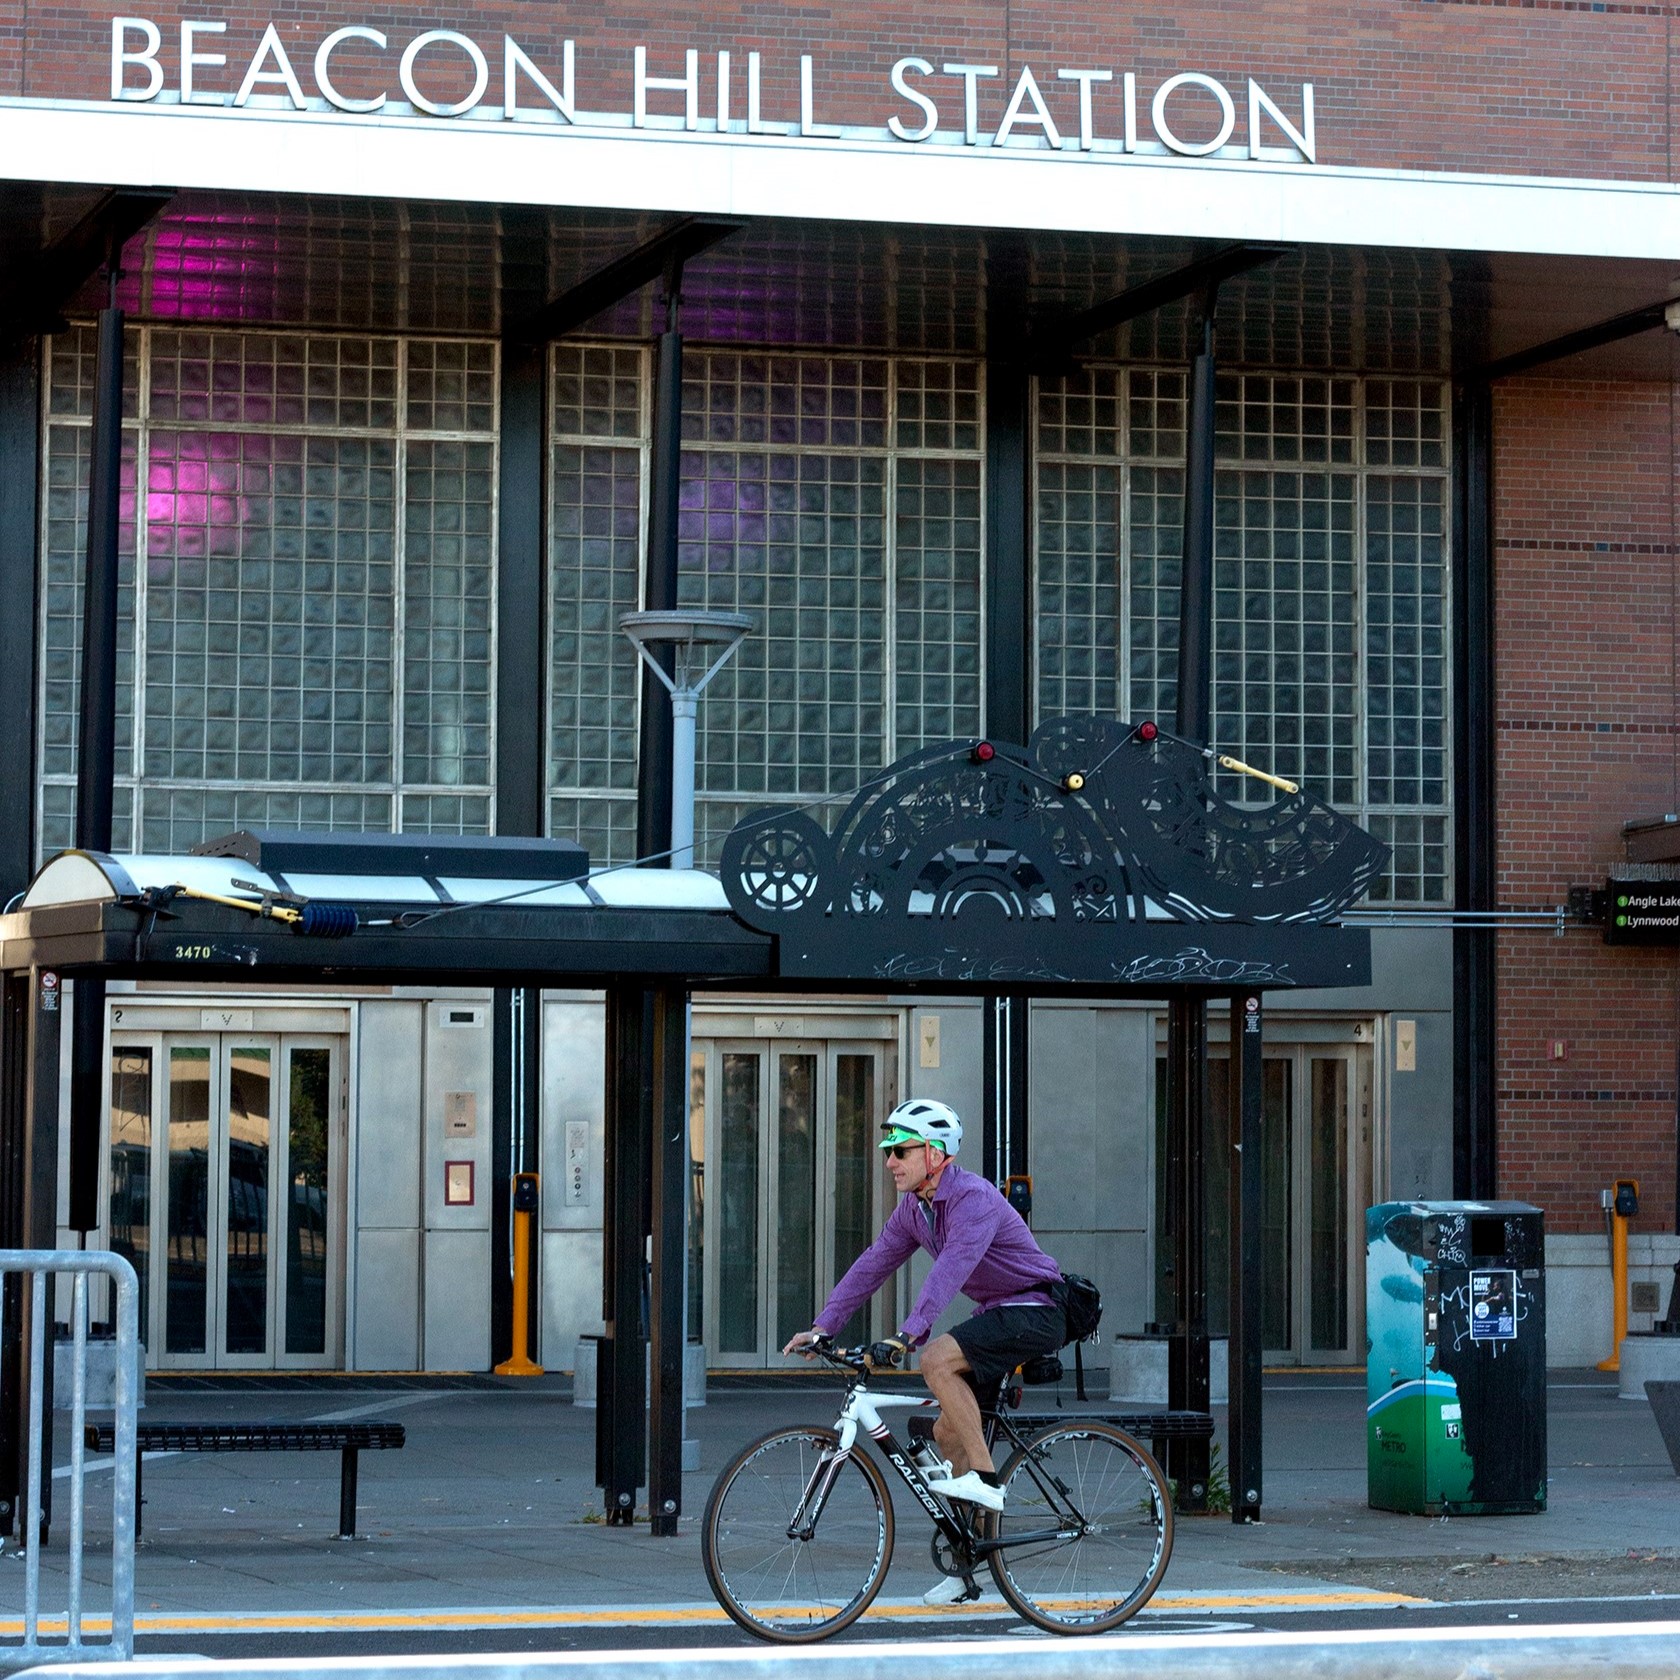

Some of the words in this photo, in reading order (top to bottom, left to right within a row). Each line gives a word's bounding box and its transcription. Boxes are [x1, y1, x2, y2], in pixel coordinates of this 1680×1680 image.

[111, 16, 575, 125] BEACON
[633, 46, 842, 139] HILL
[887, 56, 1316, 164] STATION
[1628, 895, 1657, 909] Angle
[1660, 895, 1680, 907] Lake
[1627, 915, 1680, 929] Lynnwood
[175, 945, 211, 959] 3470
[114, 1010, 123, 1023] 2
[1353, 1024, 1362, 1037] 4
[1381, 1440, 1407, 1454] METRO
[889, 1453, 945, 1520] RALEIGH
[1140, 1465, 1165, 1580] EASTON
[861, 1510, 885, 1593] EASTON
